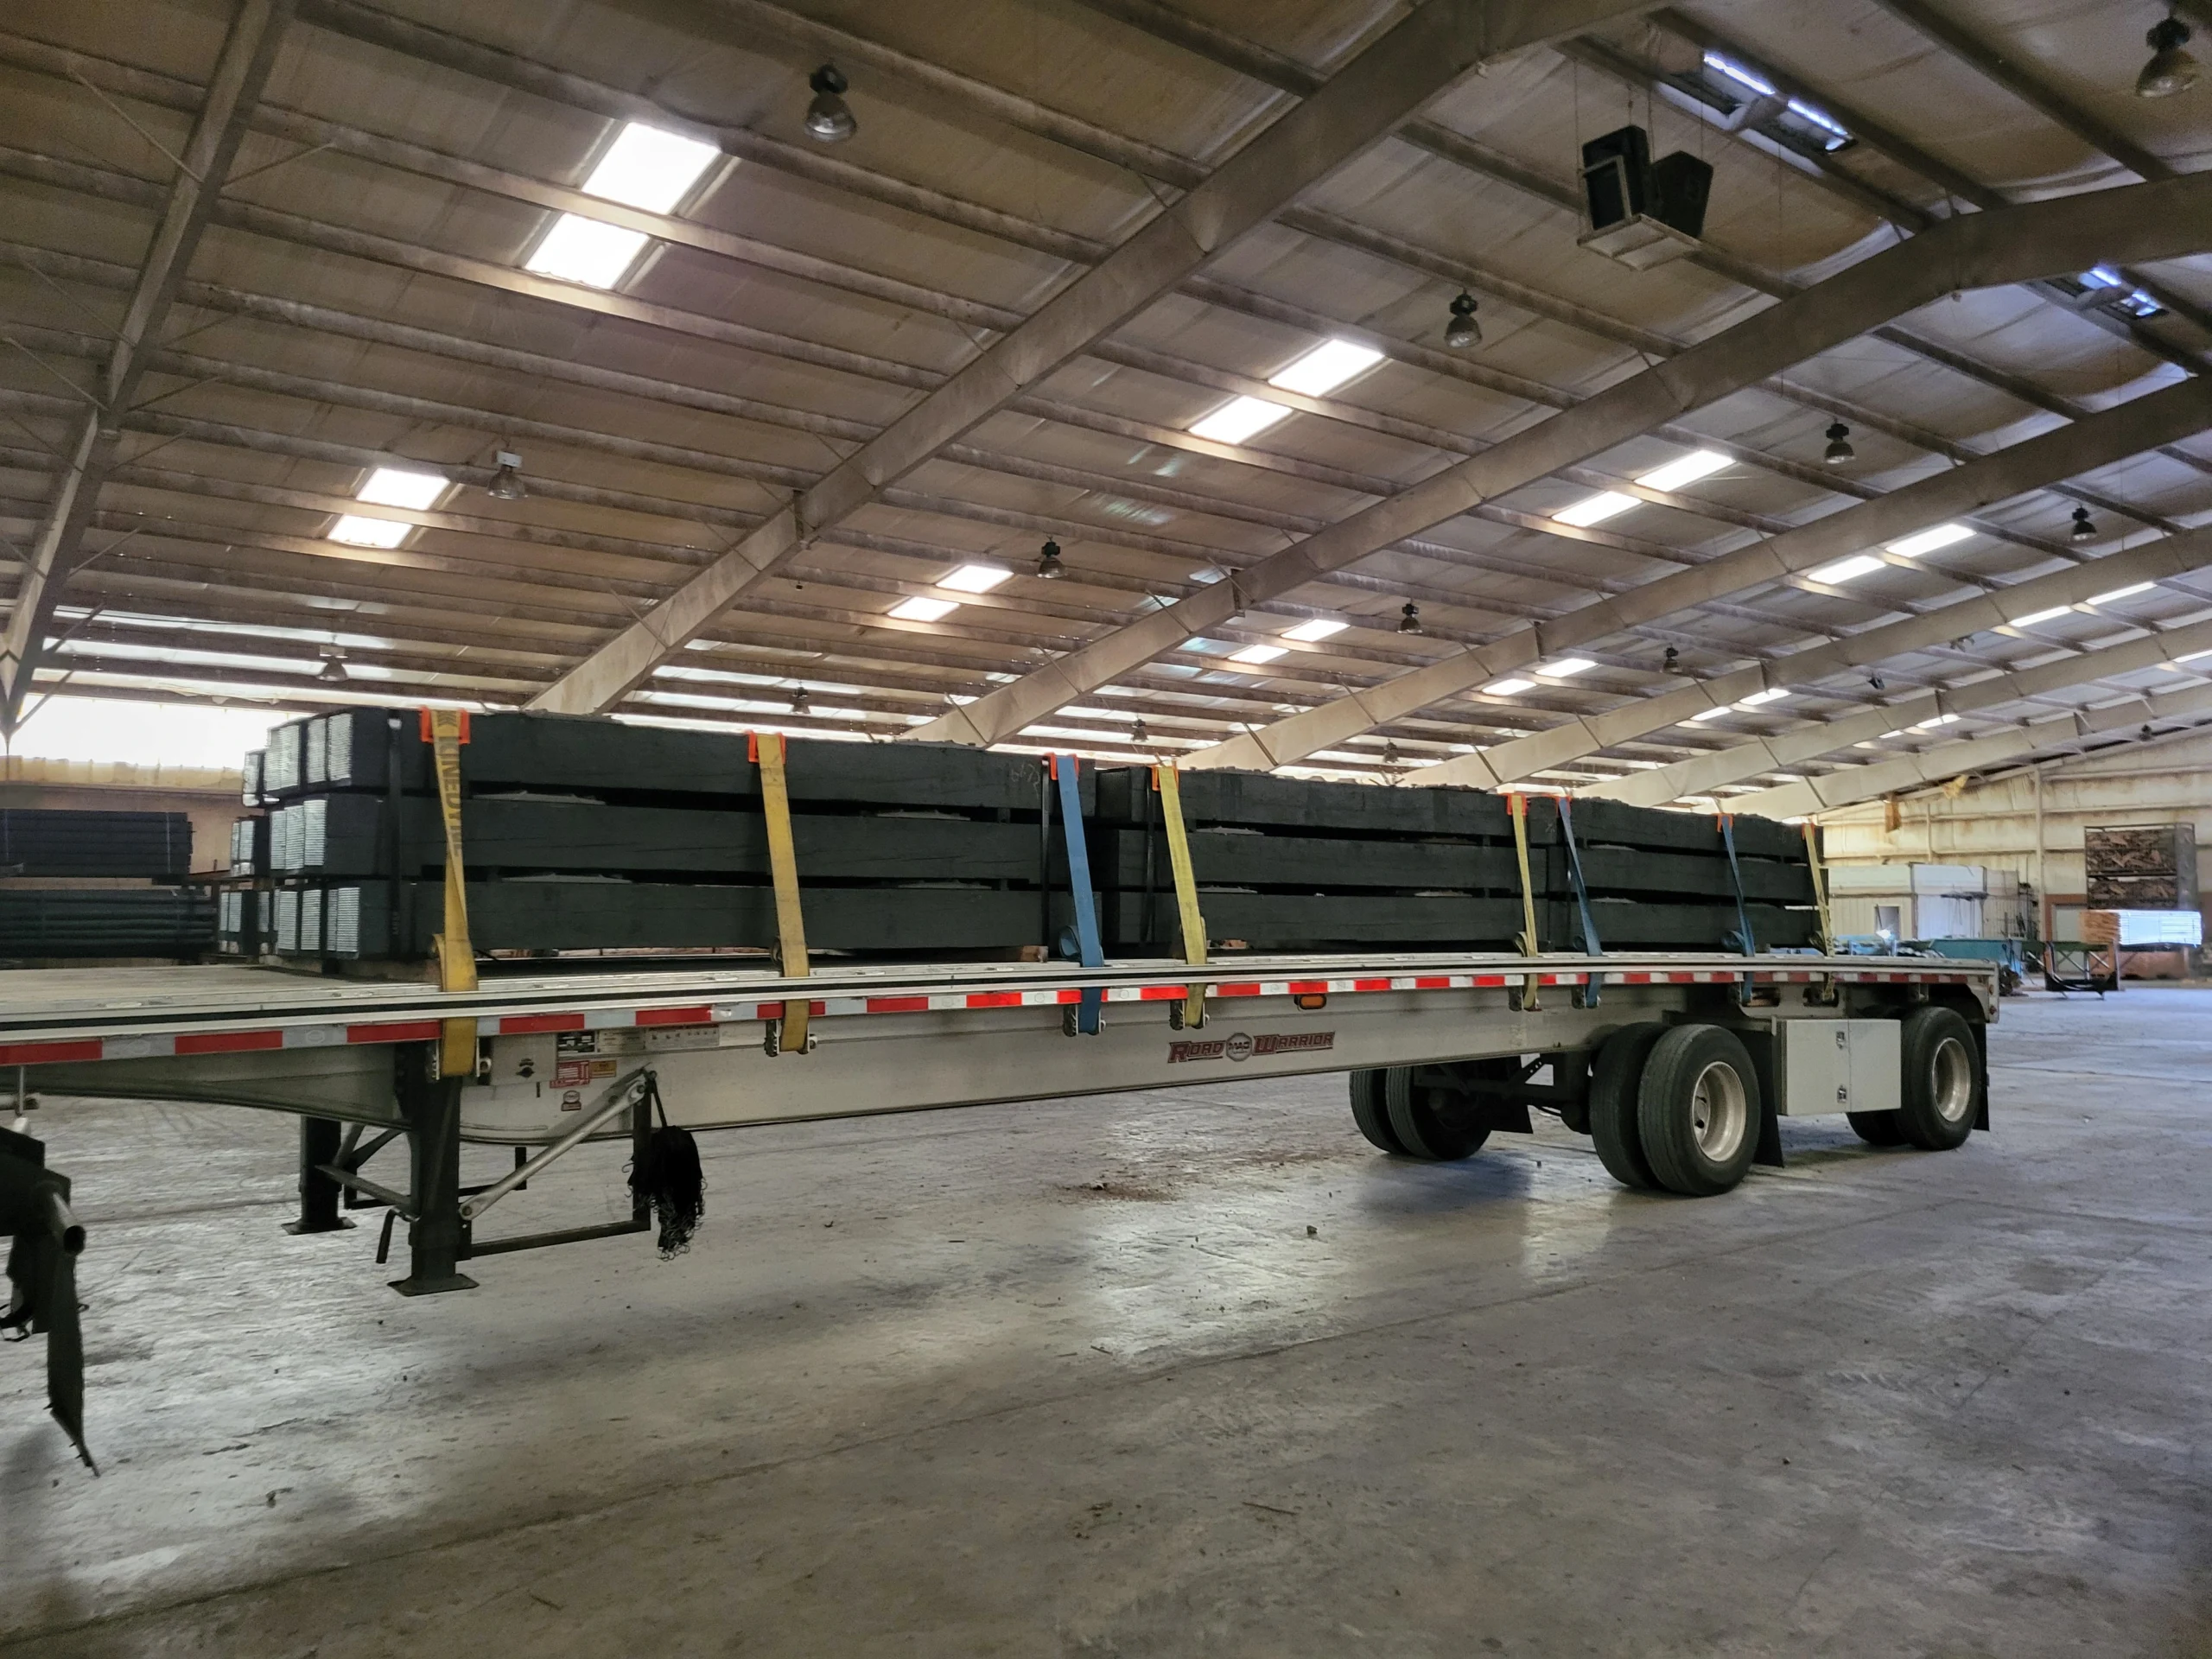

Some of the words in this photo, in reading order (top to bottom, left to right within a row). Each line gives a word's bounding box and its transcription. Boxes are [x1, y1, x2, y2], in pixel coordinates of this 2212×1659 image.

[1168, 1040, 1226, 1063] ROAD
[1252, 1032, 1336, 1056] WARRIOR
[1228, 1041, 1250, 1050] MAC
